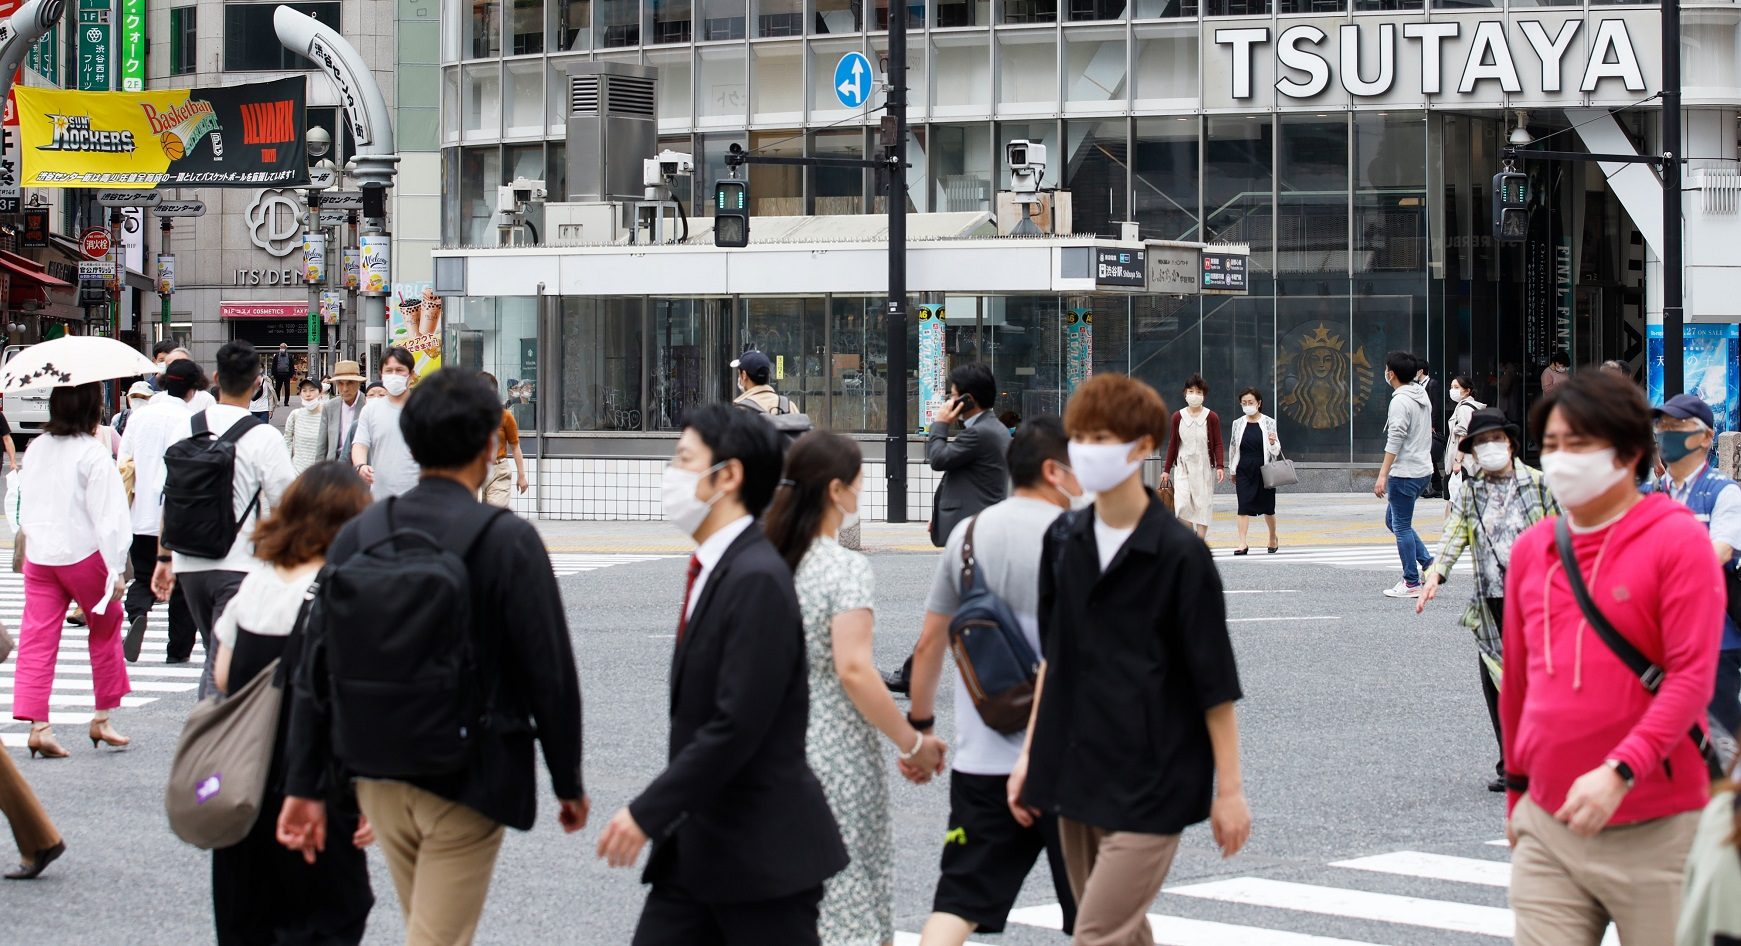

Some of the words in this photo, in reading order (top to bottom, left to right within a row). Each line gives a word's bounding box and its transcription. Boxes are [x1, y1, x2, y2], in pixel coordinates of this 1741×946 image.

[83, 12, 97, 21] 1F
[95, 44, 105, 83] 渋谷西村
[1215, 19, 1647, 99] TSUTAYA
[83, 54, 93, 90] フルーツ
[127, 80, 139, 89] 2F
[314, 42, 365, 140] 渋谷センター街
[69, 115, 91, 129] SUN
[141, 99, 213, 134] Basketball
[240, 100, 295, 145] ALVARK
[36, 113, 137, 152] ROCKERS
[101, 193, 158, 201] 渋谷センター街
[0, 200, 16, 211] 3F
[154, 204, 203, 212] 渋谷センター街
[86, 240, 108, 250] 消火栓
[1106, 265, 1123, 277] 渋谷駅
[1557, 245, 1570, 297] FINAL
[1557, 306, 1570, 351] FANT
[1683, 327, 1697, 336] .27
[1656, 355, 1714, 367] 天の子
